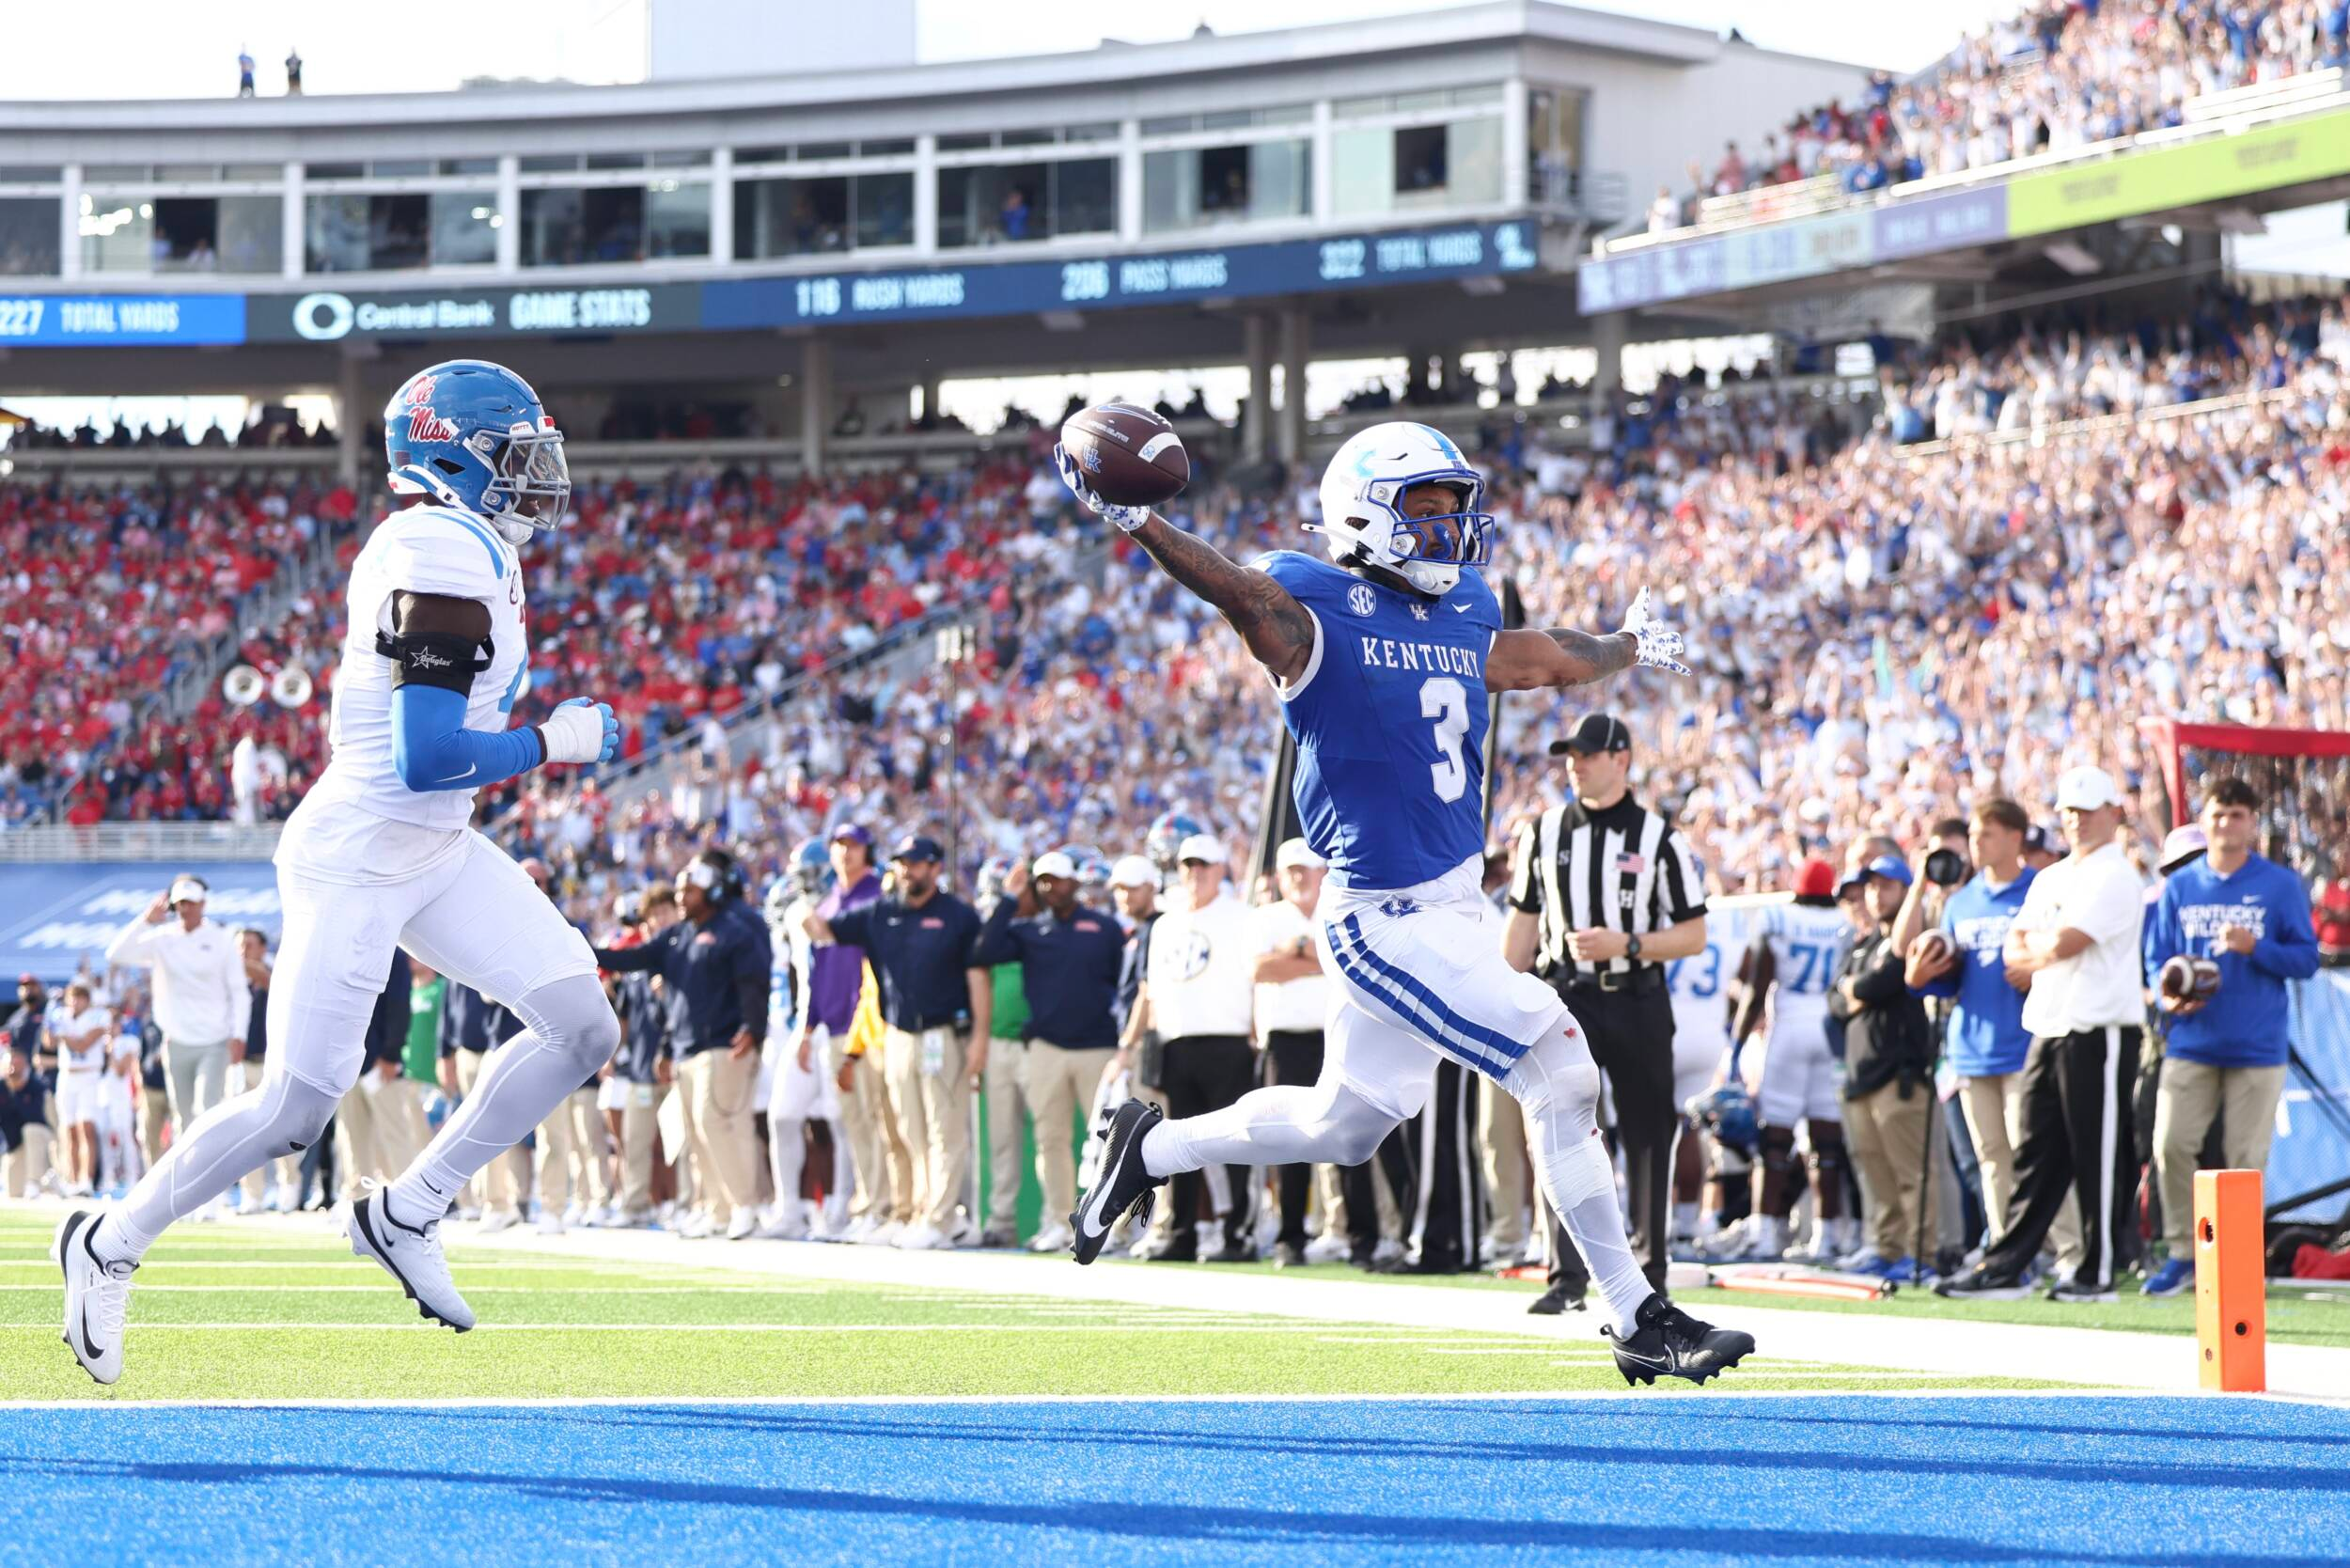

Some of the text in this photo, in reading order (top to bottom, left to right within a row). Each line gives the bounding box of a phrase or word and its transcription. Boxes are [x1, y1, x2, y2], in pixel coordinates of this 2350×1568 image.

[0, 300, 180, 336] 227 TOTAL YARDS
[356, 299, 495, 330] Central Bank
[509, 288, 651, 330] GAME STATS
[406, 375, 438, 405] Ole
[408, 405, 453, 442] Miss
[1349, 588, 1375, 615] SEC
[419, 654, 451, 666] Douglas
[1361, 636, 1481, 679] KENTUCKY
[1419, 677, 1469, 805] 3
[2178, 904, 2266, 924] KENTUCKY
[2182, 921, 2265, 939] WILDS
